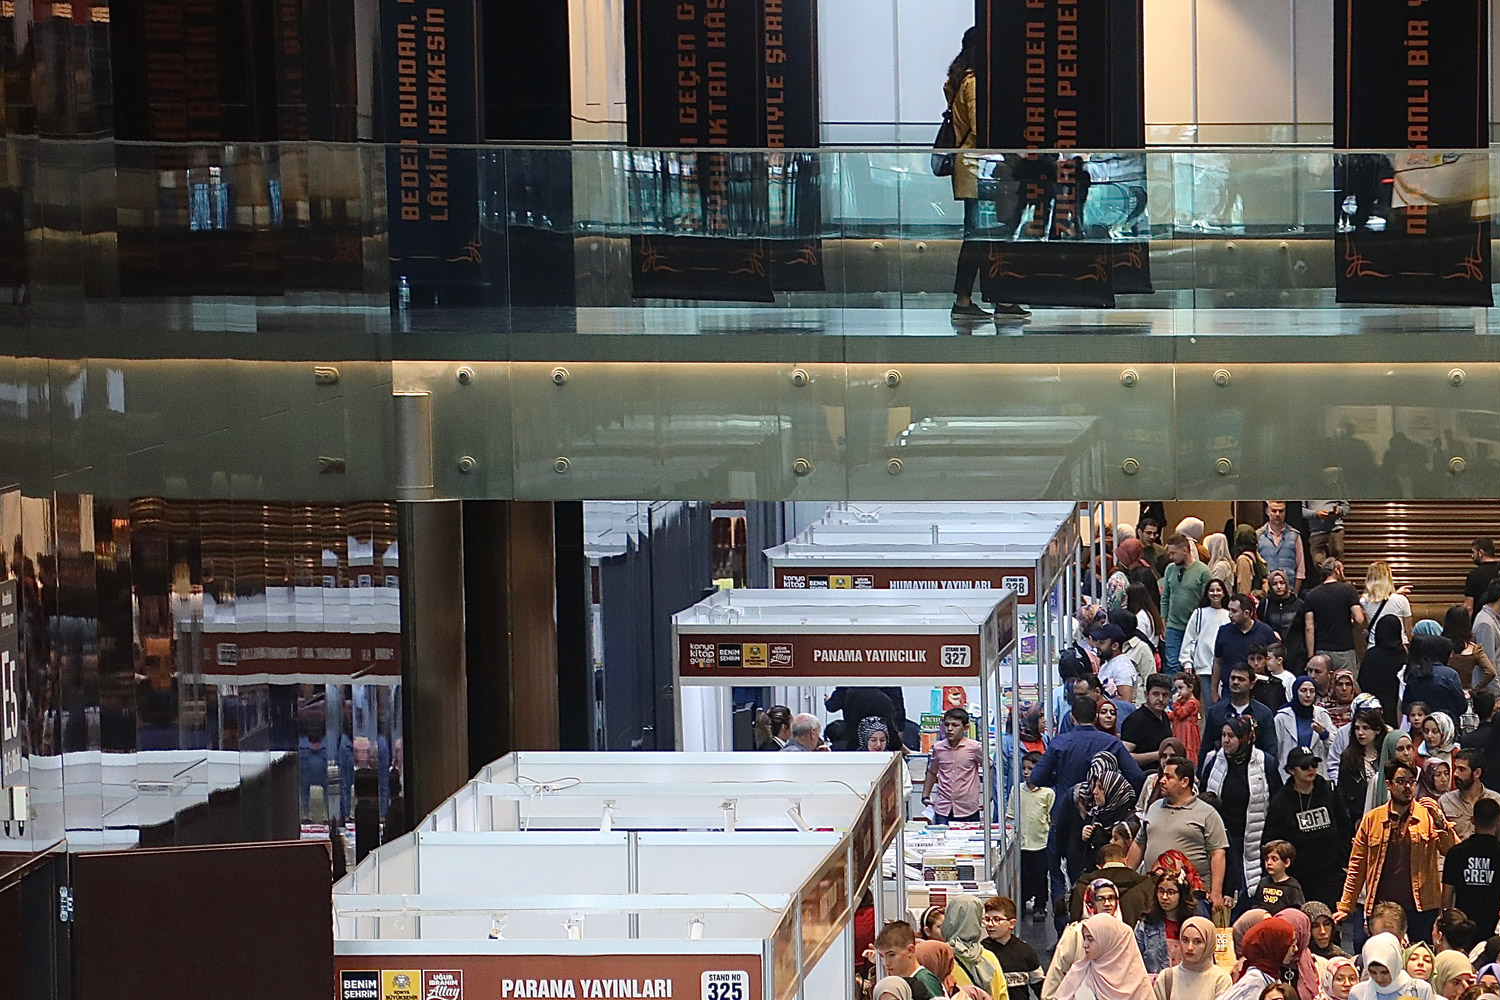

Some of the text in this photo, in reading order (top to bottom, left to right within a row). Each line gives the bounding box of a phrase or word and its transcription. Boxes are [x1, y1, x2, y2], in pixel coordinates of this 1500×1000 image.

[1404, 20, 1429, 66] BİR
[423, 8, 448, 135] HERKESİN
[677, 34, 700, 124] GEÇEN
[690, 649, 715, 659] kitap
[814, 649, 927, 662] PANAMA YAYINCILIK
[944, 652, 967, 665] 327
[1468, 857, 1491, 869] SKM
[1464, 868, 1494, 884] CREW
[343, 980, 377, 989] BENİM
[708, 974, 730, 982] STAND
[344, 990, 377, 999] ŞEHRİM
[502, 979, 673, 998] PARANA YAYINLARI
